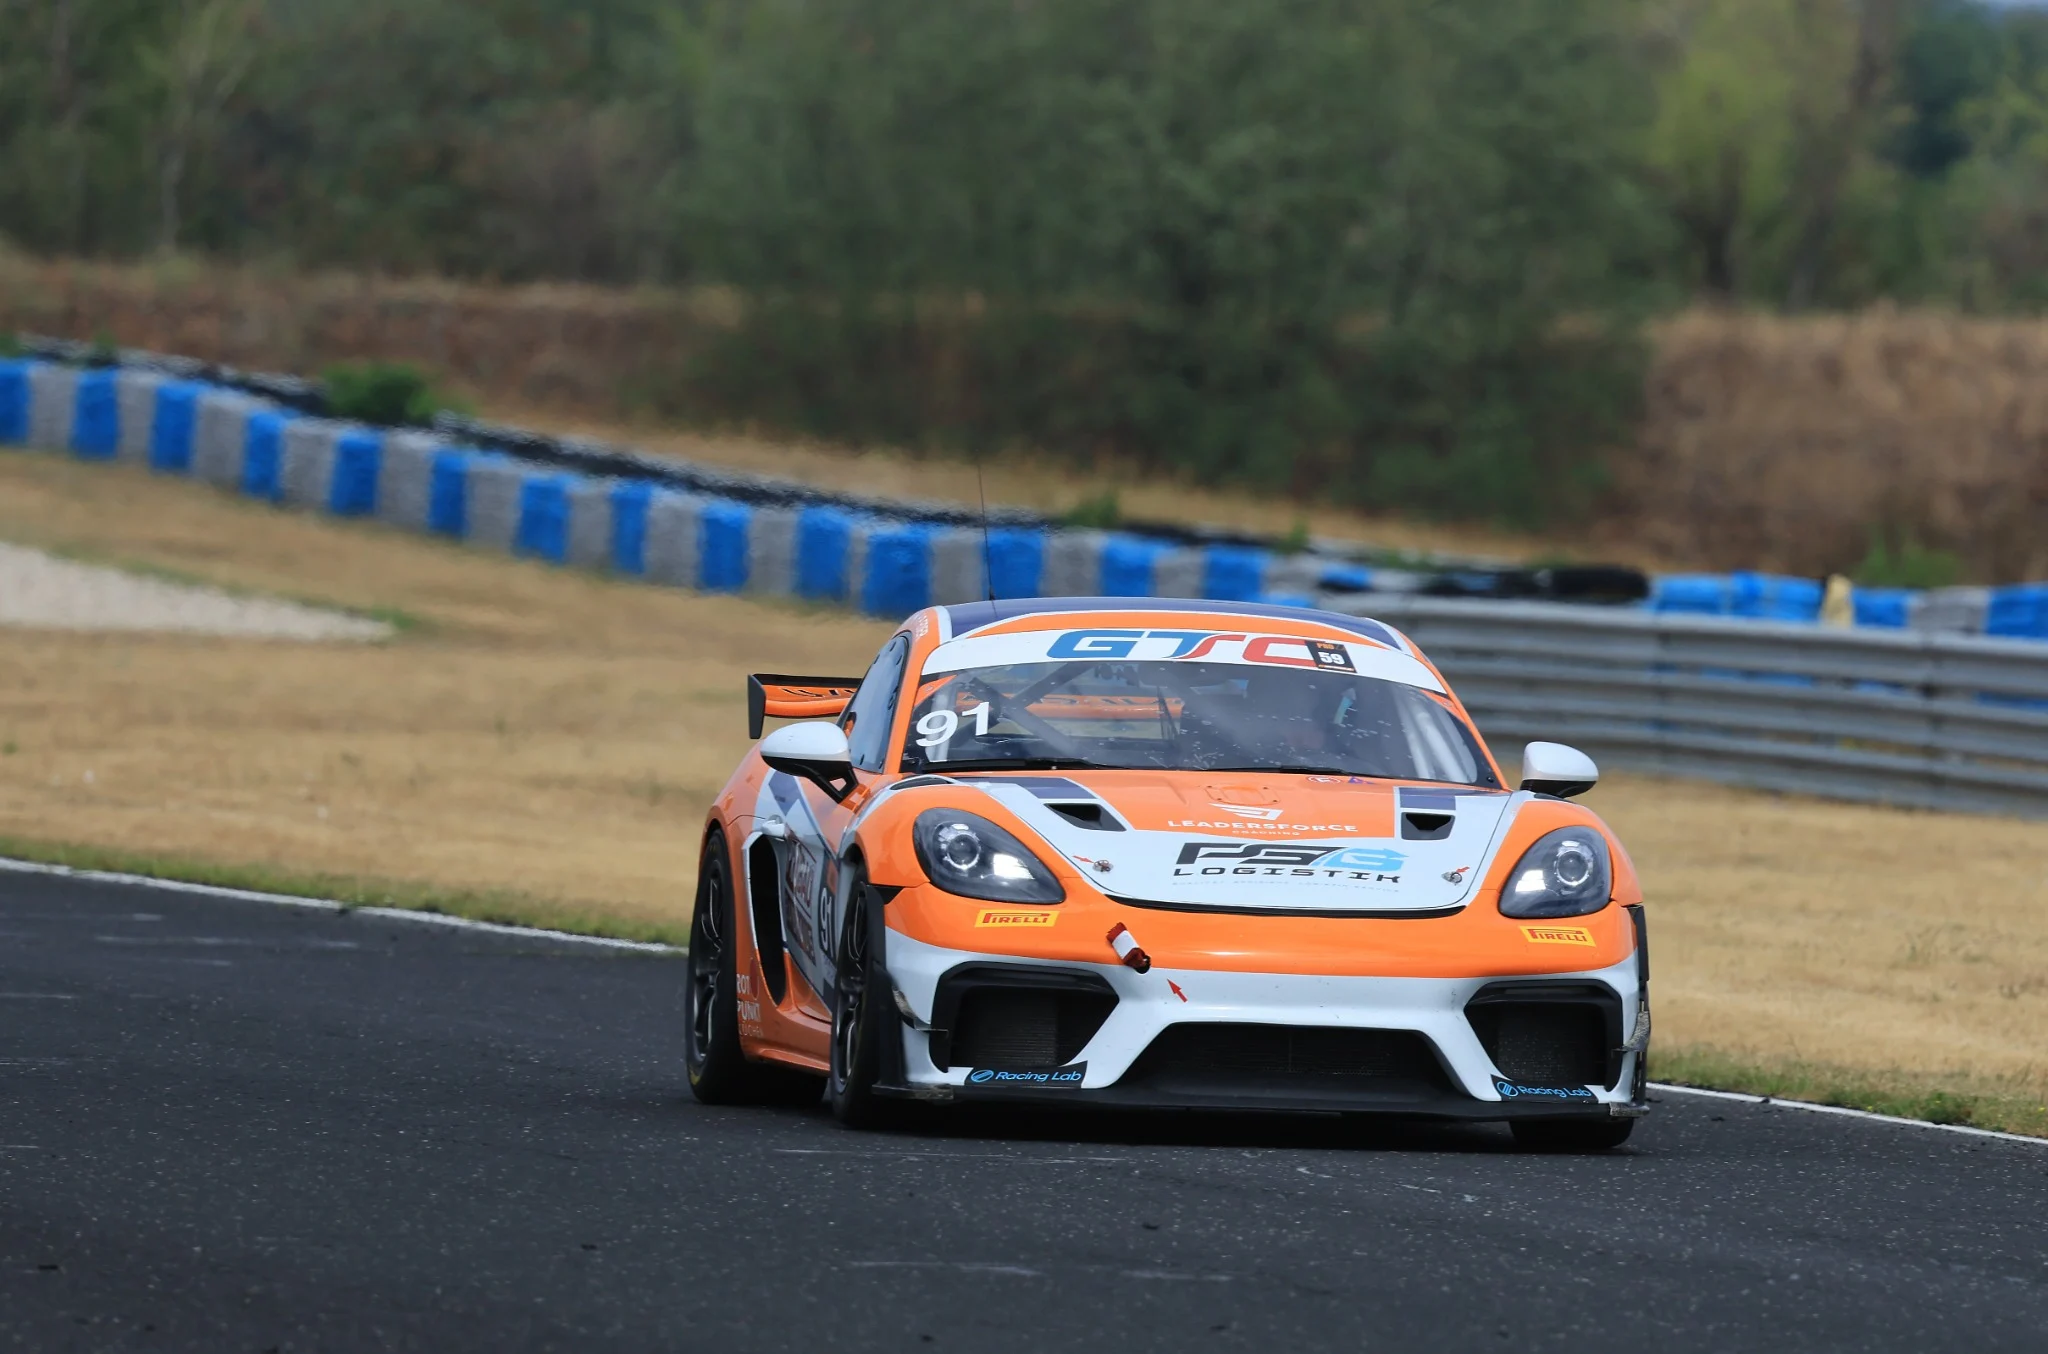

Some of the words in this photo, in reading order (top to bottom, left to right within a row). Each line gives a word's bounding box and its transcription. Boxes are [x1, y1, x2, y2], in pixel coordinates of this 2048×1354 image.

[1318, 651, 1345, 665] 59
[915, 701, 990, 747] 91
[1168, 820, 1359, 832] LEADERSFORCE
[1173, 867, 1401, 884] LOGISTIK
[820, 887, 835, 958] 91
[982, 912, 1051, 924] PIRELLI
[1526, 928, 1588, 942] PIRELLI
[995, 1071, 1050, 1082] Racing
[1051, 1070, 1082, 1081] Lab
[1516, 1085, 1567, 1098] Racing
[1562, 1087, 1592, 1097] Lab
